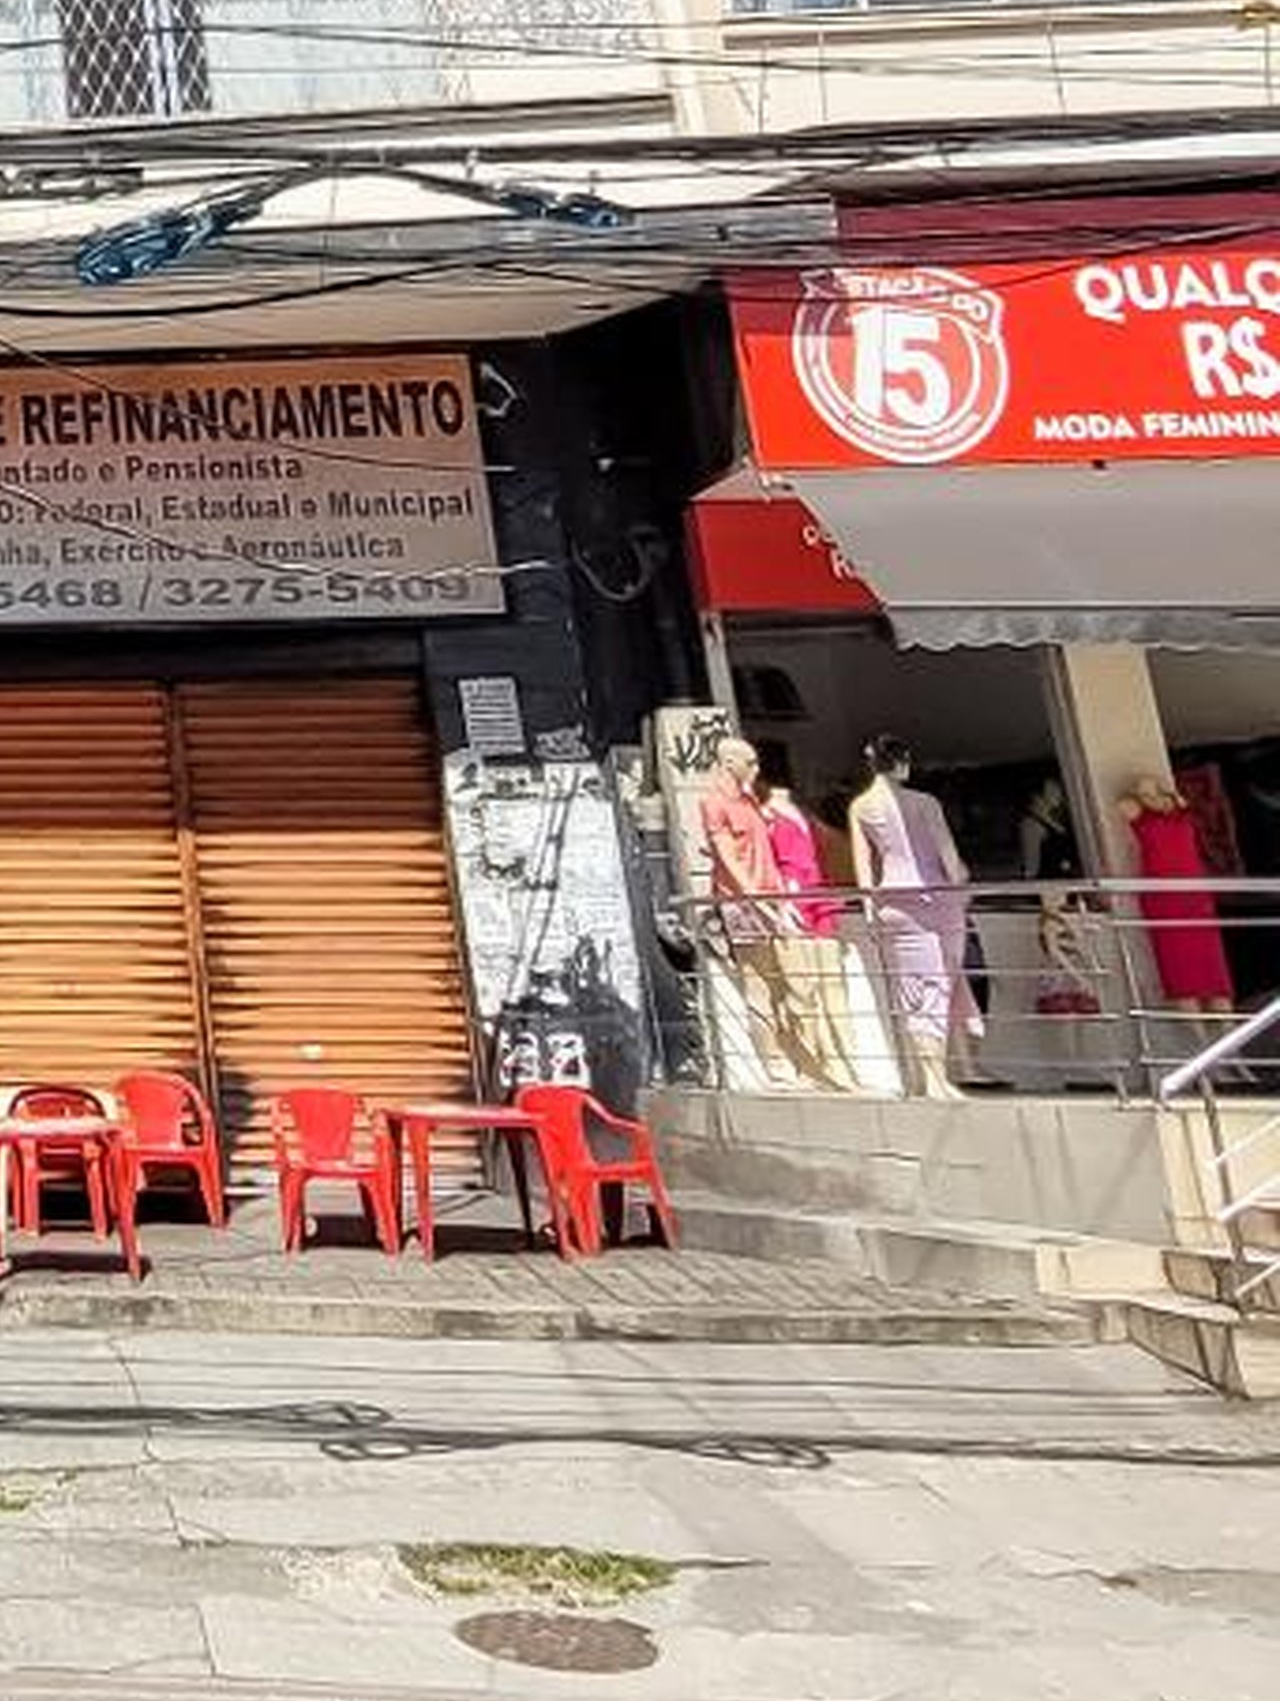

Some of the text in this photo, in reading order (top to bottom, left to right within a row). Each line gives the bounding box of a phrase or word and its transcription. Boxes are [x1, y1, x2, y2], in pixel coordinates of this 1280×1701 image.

[851, 307, 951, 426] 15
[21, 379, 464, 446] REFINANCIAMENTO
[1034, 413, 1138, 440] MODA
[98, 462, 116, 481] e
[125, 454, 304, 483] Pensionista
[161, 492, 292, 523] Estadual
[300, 497, 320, 517] e
[328, 487, 474, 524] Municipal
[222, 532, 406, 561] Aeronáutica
